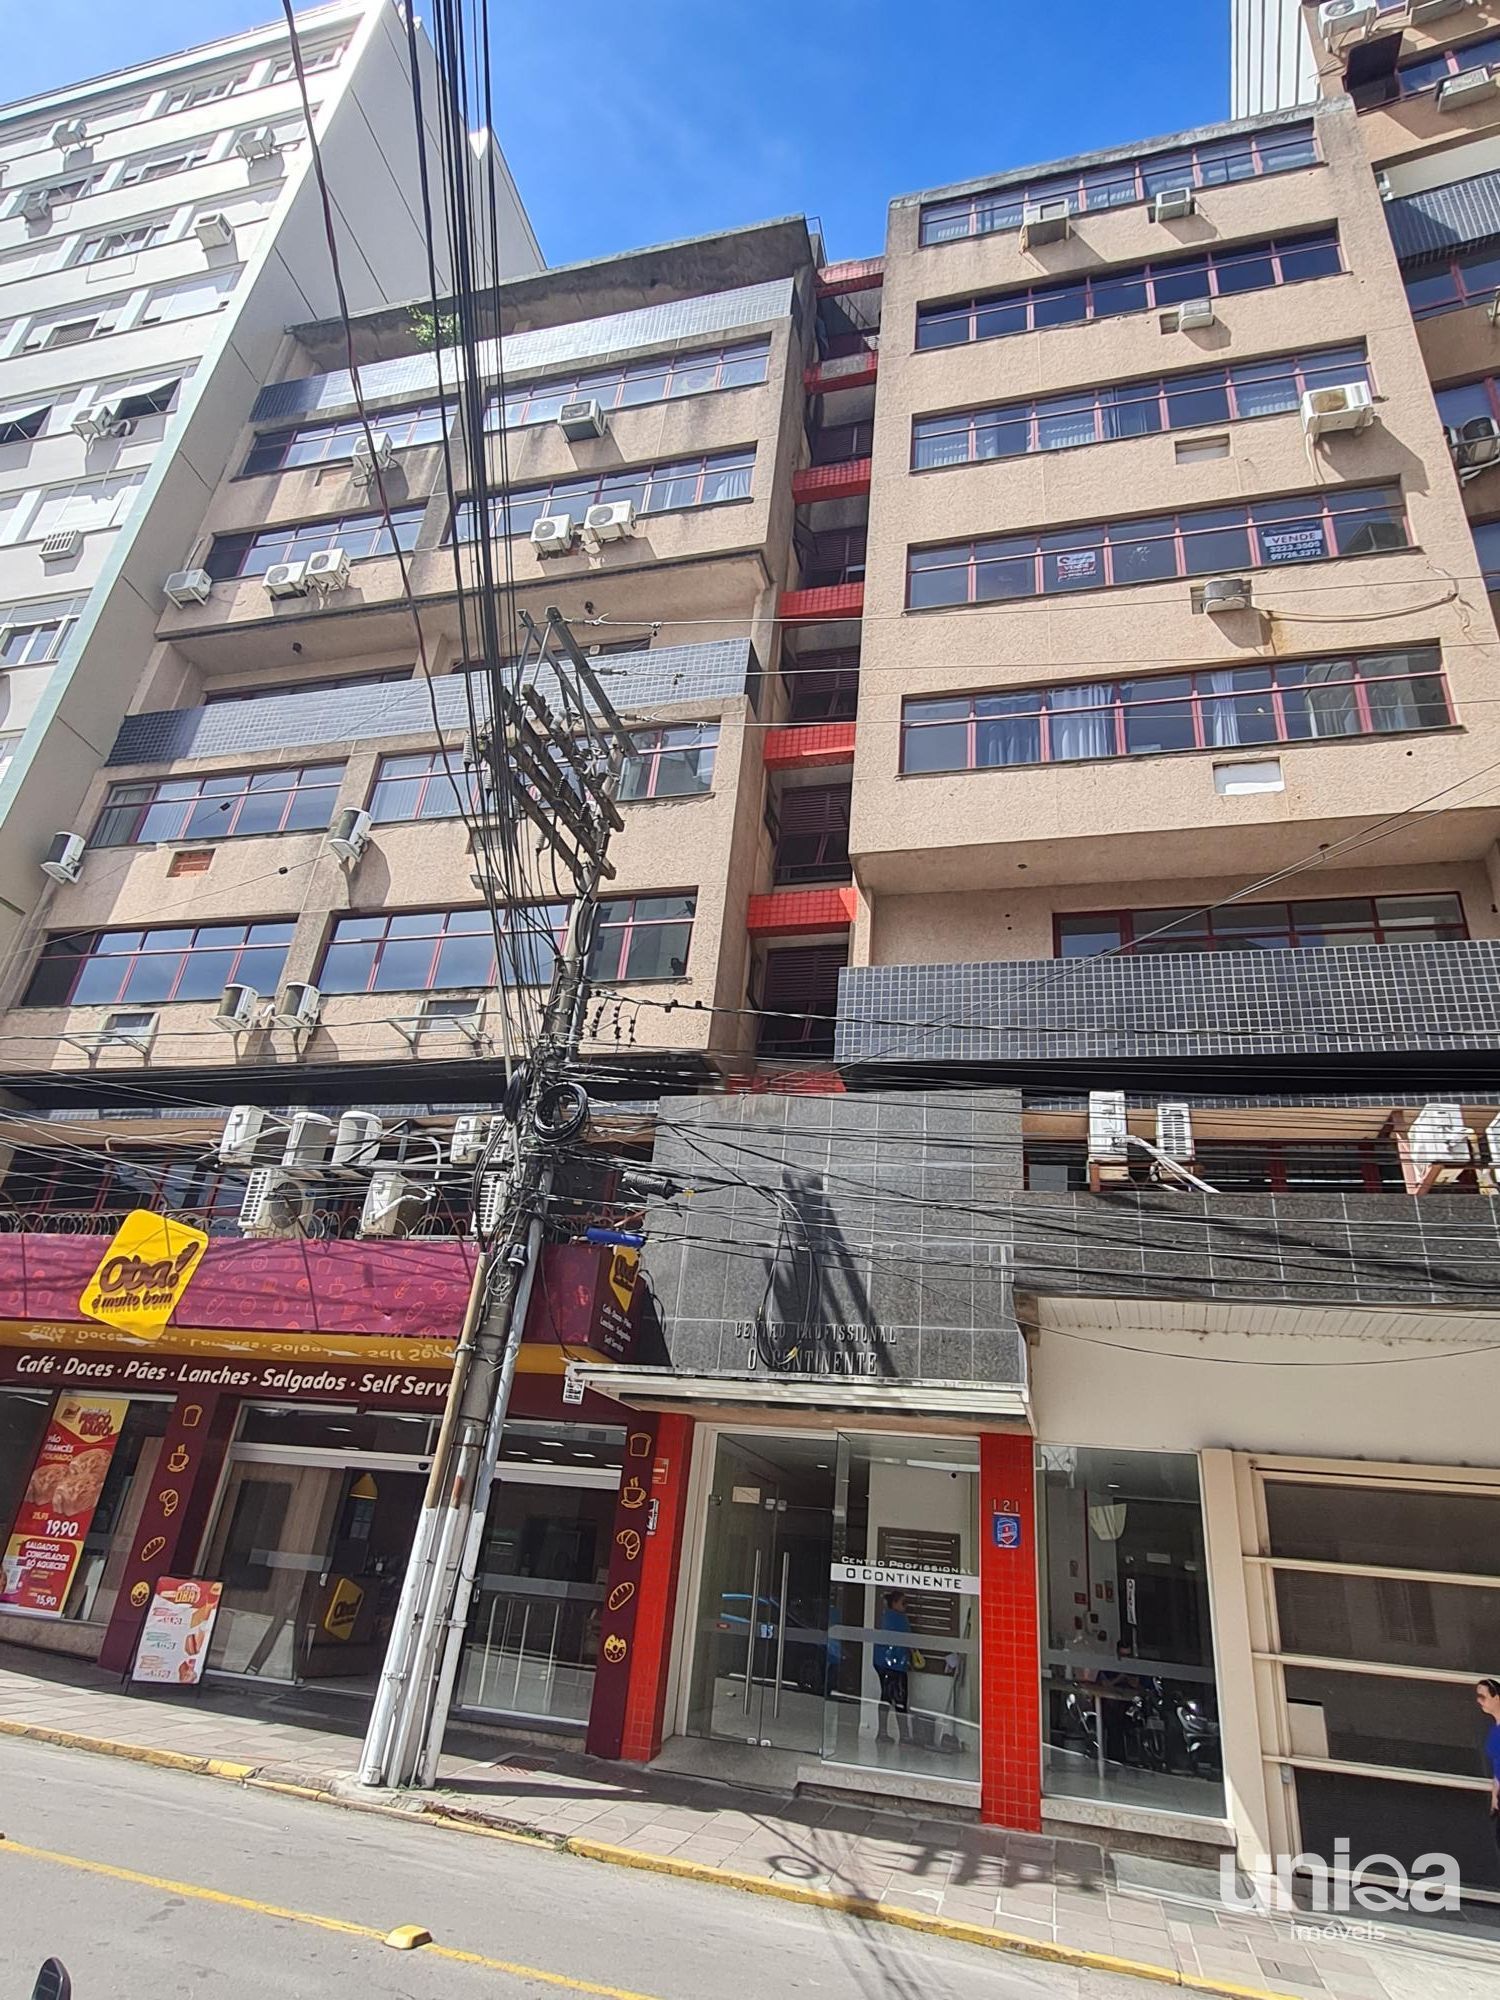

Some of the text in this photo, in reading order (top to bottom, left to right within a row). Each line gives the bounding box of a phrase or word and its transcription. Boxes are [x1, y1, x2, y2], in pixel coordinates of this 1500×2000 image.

[1272, 532, 1317, 544] VENDE
[100, 1241, 199, 1292] Oba!
[101, 1292, 140, 1308] muito
[142, 1290, 173, 1306] bom
[747, 1347, 757, 1370] O
[16, 1355, 54, 1374] Café
[63, 1357, 115, 1377] Doces
[124, 1360, 167, 1380] Pães
[177, 1364, 250, 1386] Lanches
[260, 1368, 347, 1393] Salgados
[359, 1373, 402, 1395] Self
[992, 1499, 1019, 1513] 121
[45, 1519, 79, 1538] 19,90
[25, 1541, 60, 1551] SALGADOS
[26, 1550, 70, 1562] CONGELADOS
[846, 1568, 962, 1590] O CONTINENTE
[36, 1595, 57, 1606] 15,90
